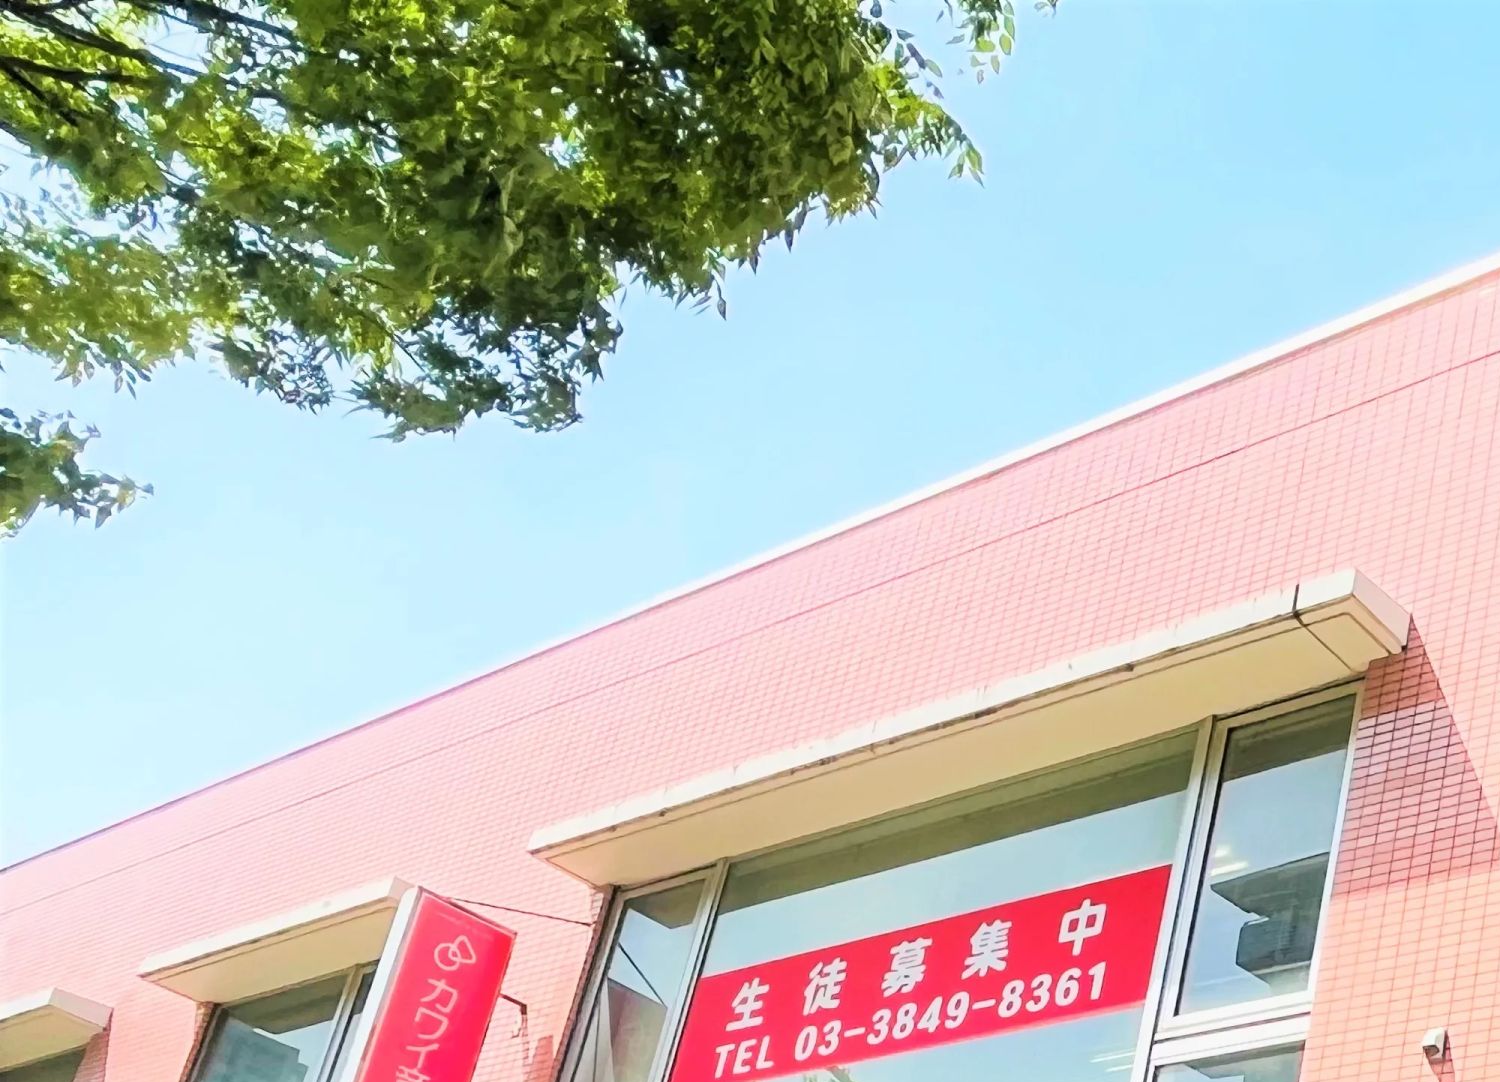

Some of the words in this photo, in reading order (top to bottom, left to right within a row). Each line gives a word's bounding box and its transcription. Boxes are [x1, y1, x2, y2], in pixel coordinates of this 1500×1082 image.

[713, 1036, 774, 1079] TEL
[794, 962, 1107, 1062] 03-3849-8361
[725, 898, 1107, 1032] 生徒募集中
